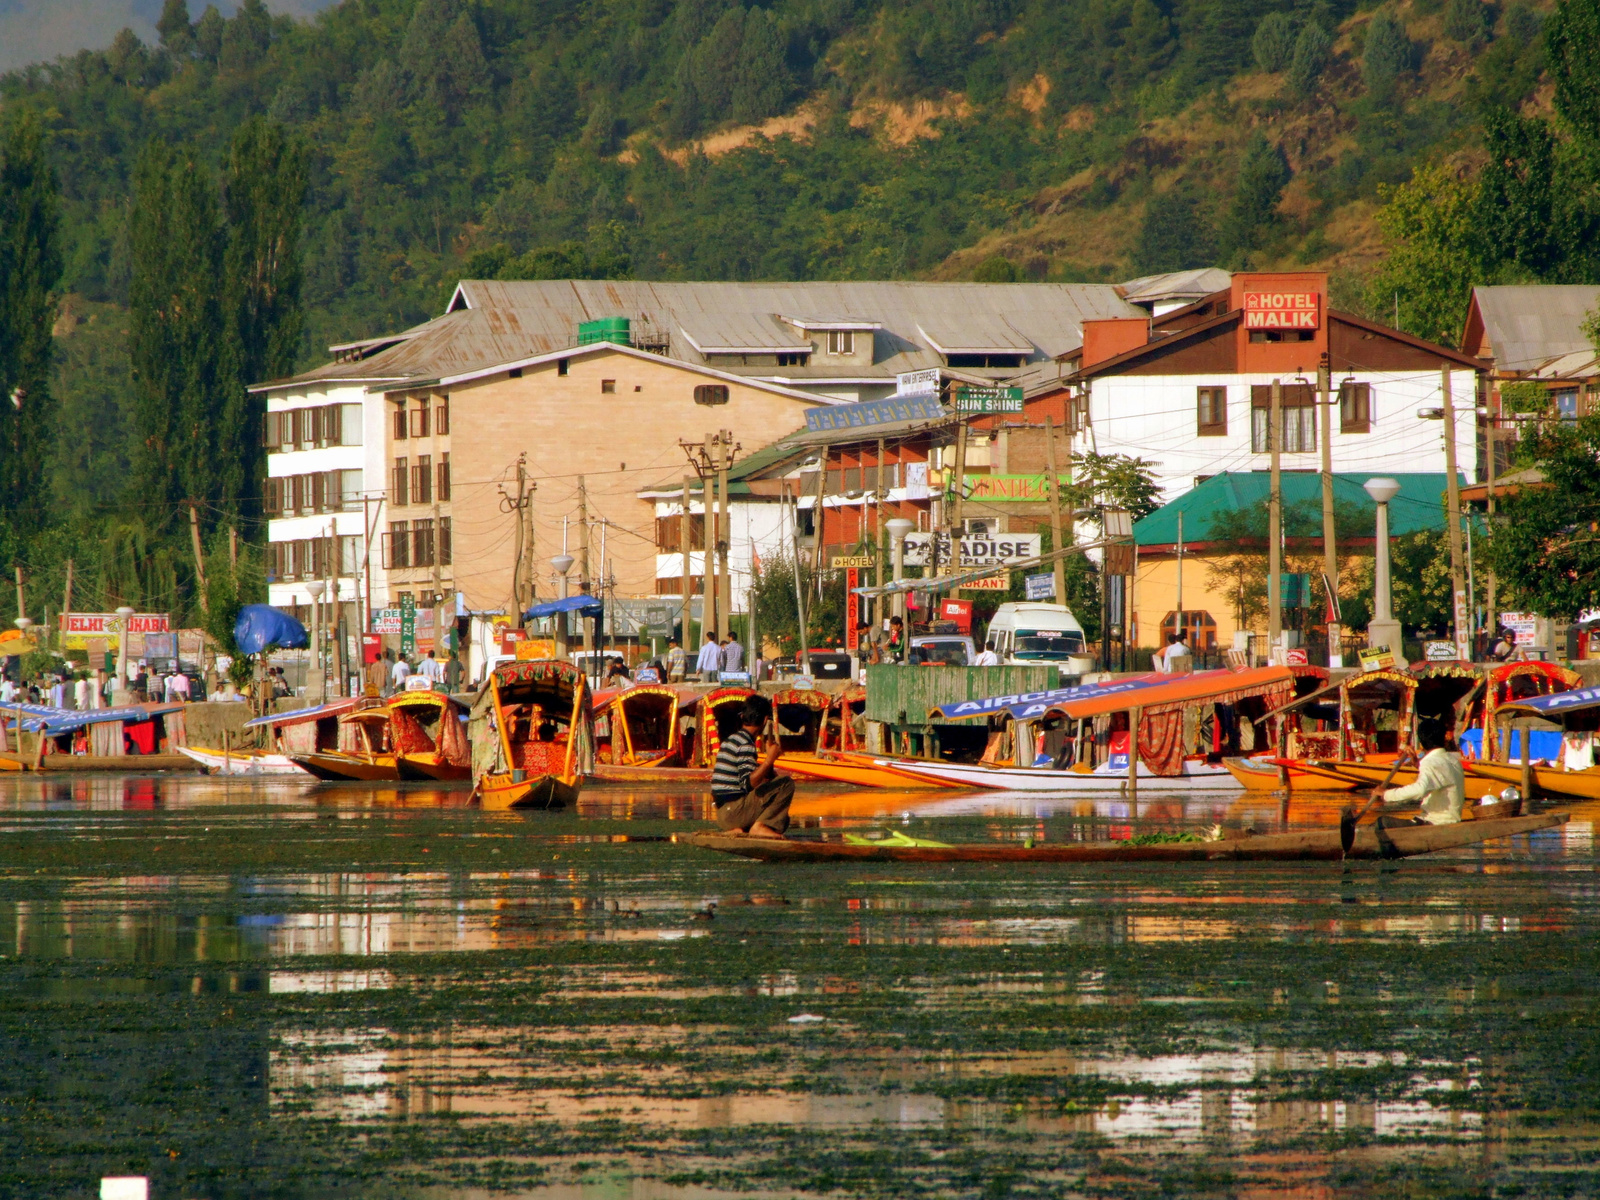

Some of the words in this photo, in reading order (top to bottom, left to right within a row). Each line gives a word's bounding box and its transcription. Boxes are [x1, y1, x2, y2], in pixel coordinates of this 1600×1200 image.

[1260, 294, 1315, 308] HOTEL
[1247, 312, 1315, 327] MALIK
[968, 389, 1012, 399] HOTEL
[957, 400, 982, 411] SUN
[986, 400, 1022, 411] SHINE
[904, 541, 1030, 557] PARADISE
[843, 557, 873, 566] HOTEL
[948, 605, 967, 614] Airtel
